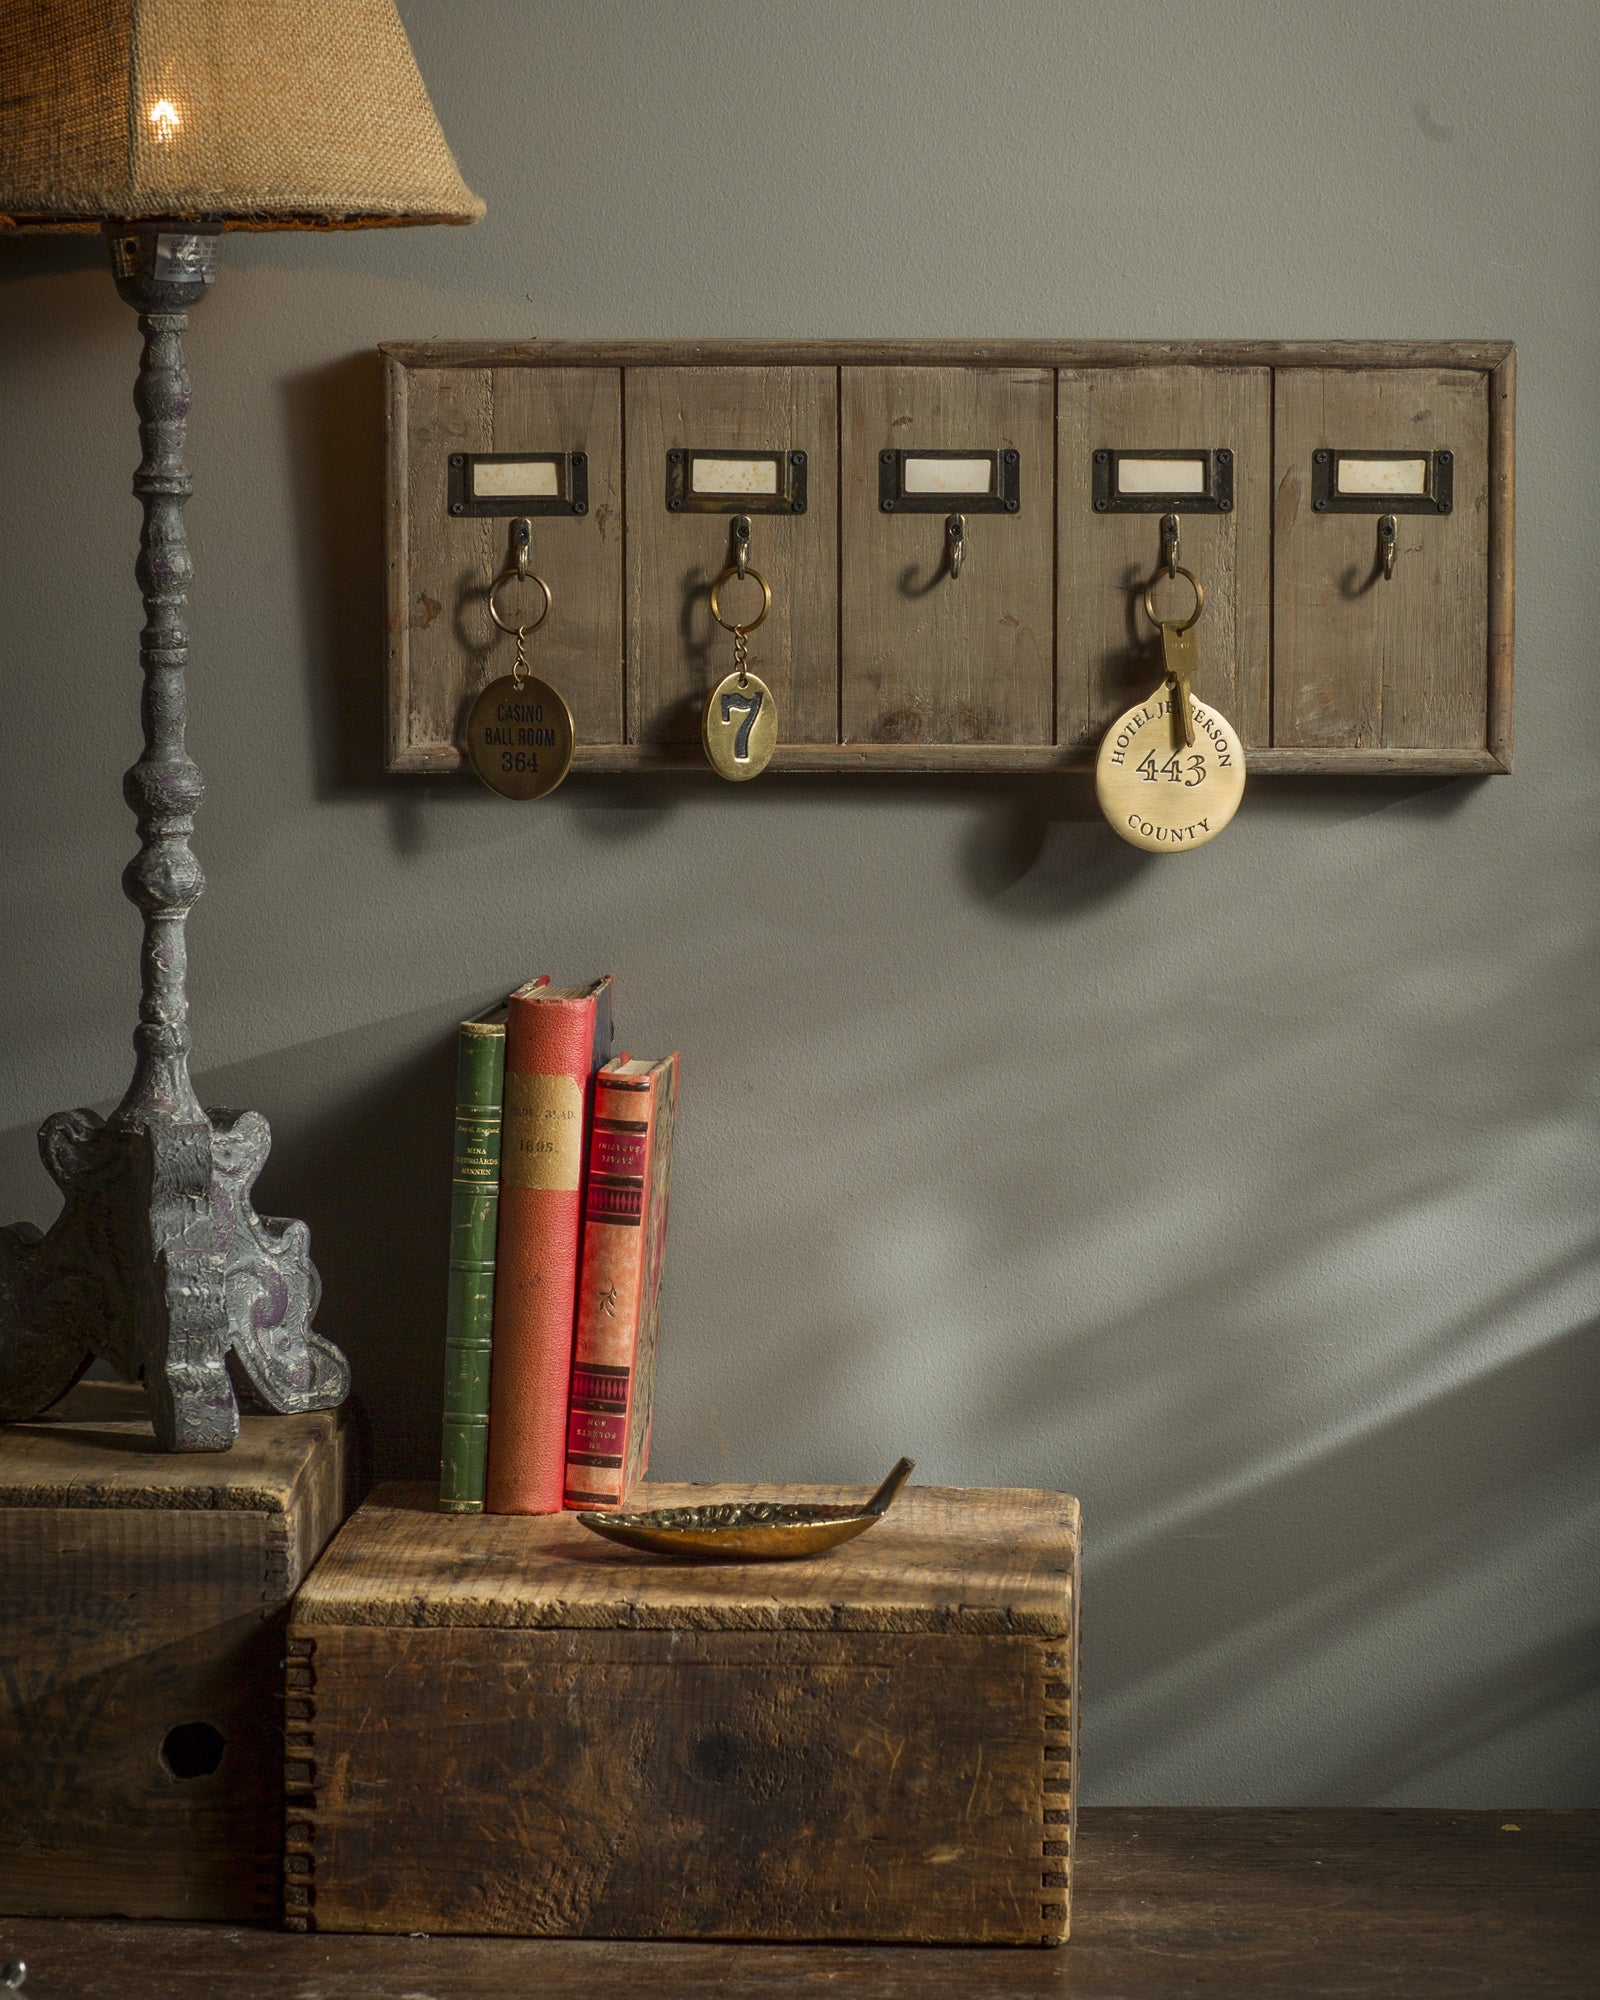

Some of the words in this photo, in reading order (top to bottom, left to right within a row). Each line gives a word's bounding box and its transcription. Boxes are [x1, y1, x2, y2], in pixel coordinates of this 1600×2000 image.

[497, 704, 543, 723] CASINO
[484, 727, 515, 746] BALL
[518, 728, 556, 747] ROOM
[721, 691, 764, 762] 7
[1111, 706, 1155, 766] HOTEL
[1156, 700, 1233, 768] JEERSON
[501, 751, 539, 773] 364
[1135, 748, 1207, 787] 443
[1127, 814, 1213, 842] COUNTY
[466, 1147, 487, 1155] MINA
[461, 1168, 492, 1176] MINNEN
